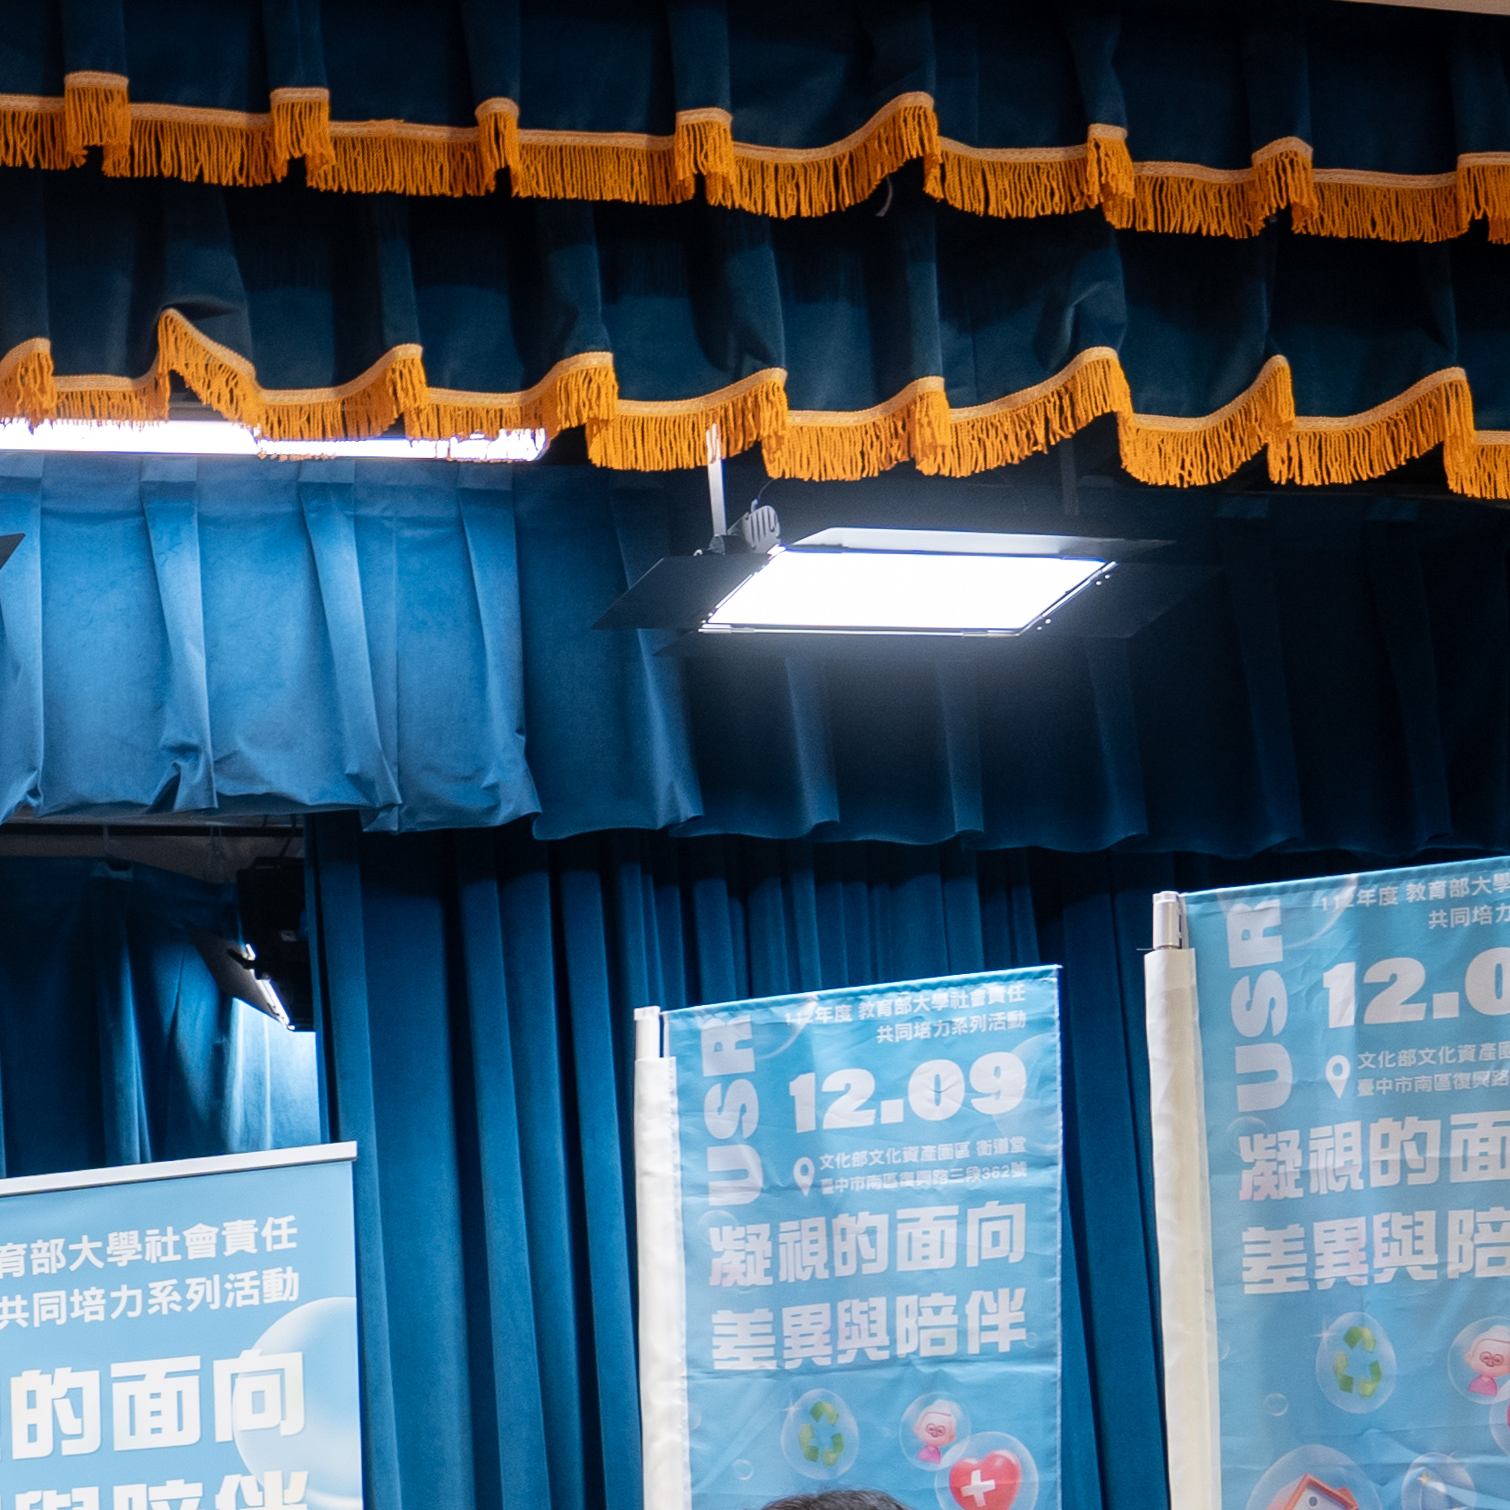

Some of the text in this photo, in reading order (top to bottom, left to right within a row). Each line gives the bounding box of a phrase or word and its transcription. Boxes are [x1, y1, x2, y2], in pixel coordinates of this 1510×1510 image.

[858, 983, 1026, 1021] 教育部大學社會責任
[876, 1010, 1026, 1044] 共同培力系列活動
[1225, 898, 1293, 1113] USR
[699, 1014, 765, 1207] USR
[787, 1051, 1027, 1133] 12.09
[708, 1201, 1027, 1287] 凝視的面向
[710, 1287, 1027, 1371] 差異與陪伴
